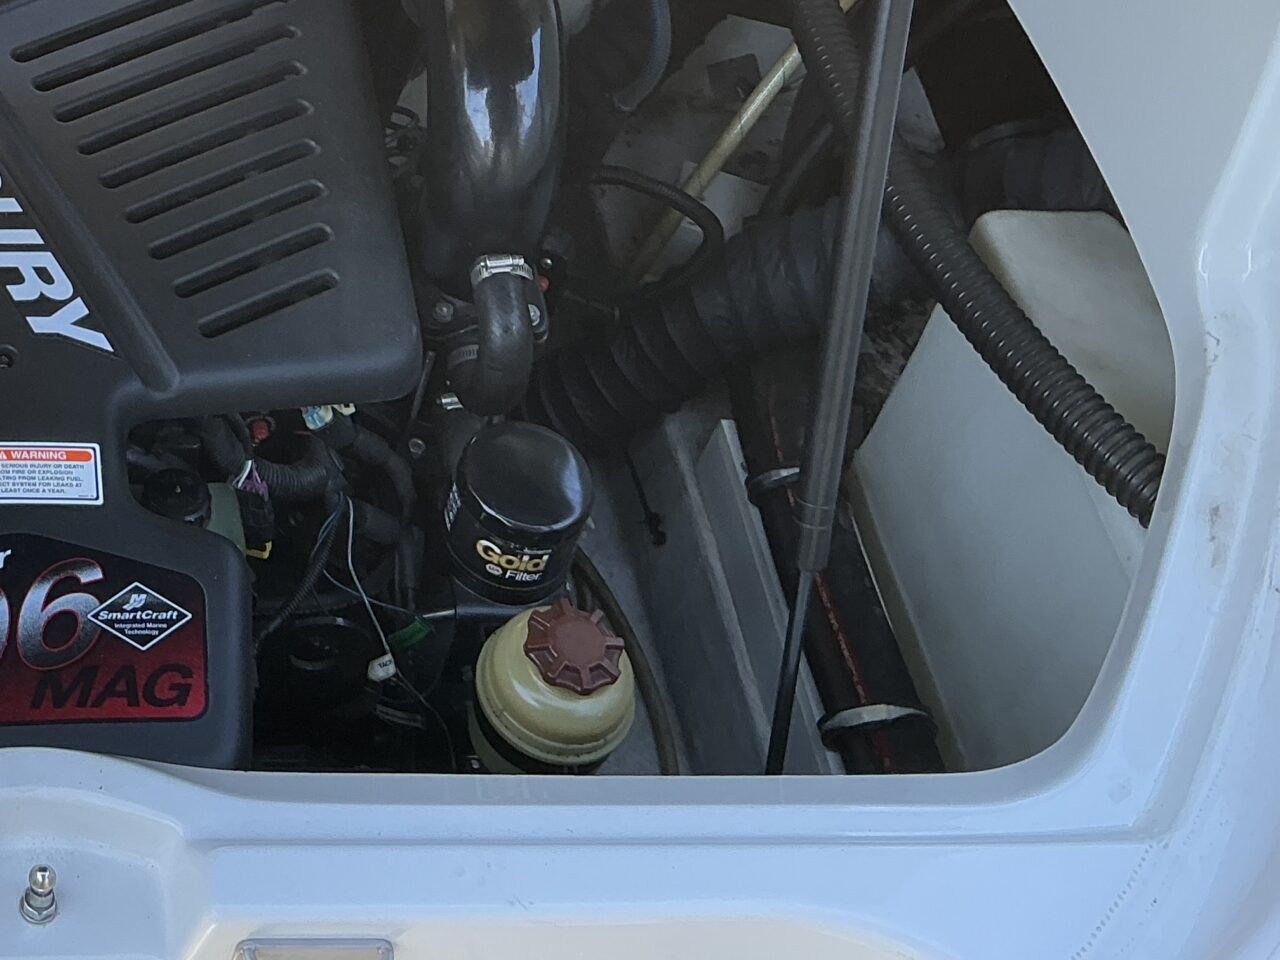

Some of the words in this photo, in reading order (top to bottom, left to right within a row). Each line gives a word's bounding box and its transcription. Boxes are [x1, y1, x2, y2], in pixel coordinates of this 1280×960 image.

[11, 451, 67, 460] WARNING
[476, 539, 549, 571] Gold
[505, 570, 542, 581] Filter
[98, 610, 179, 620] SmartCraft
[114, 622, 145, 630] Integrated
[124, 629, 159, 637] Technology
[30, 663, 194, 709] MAG
